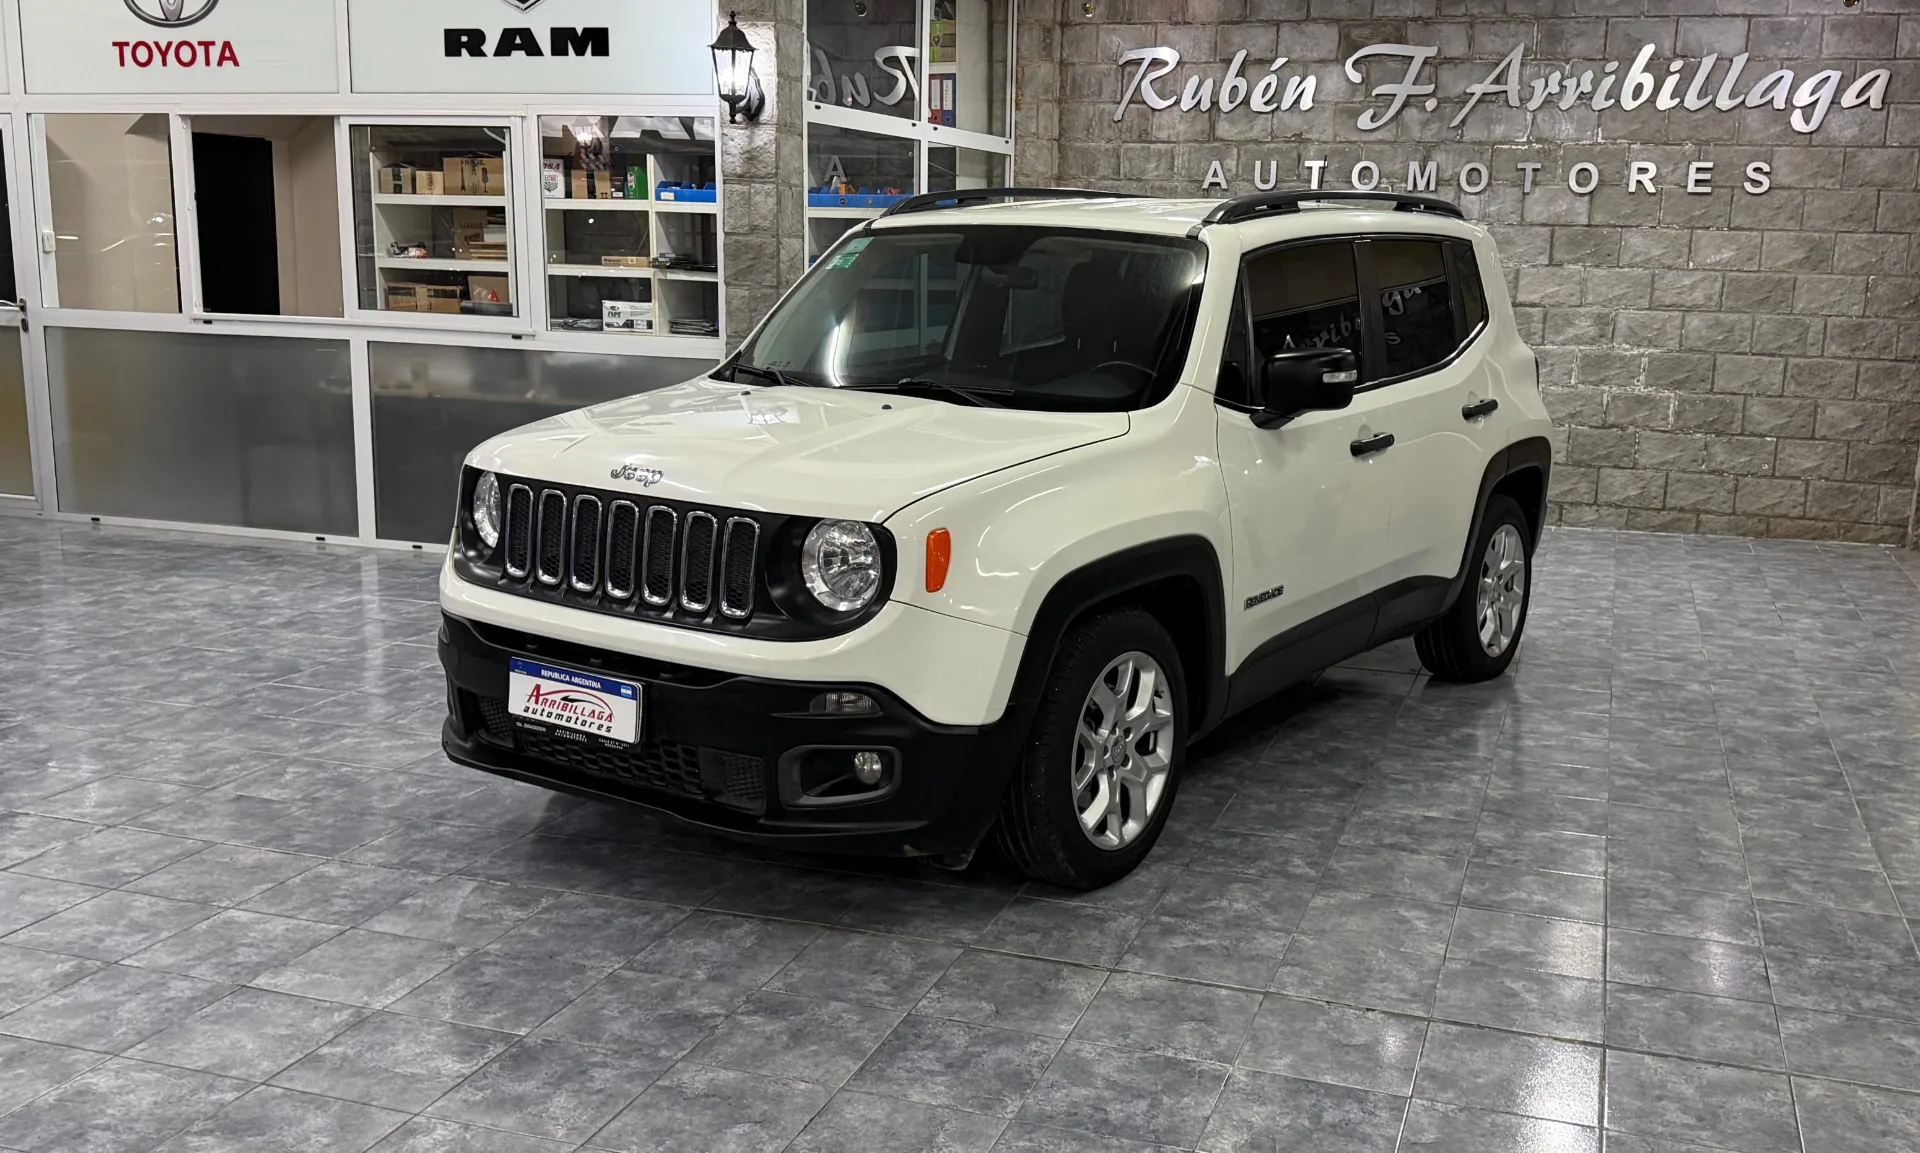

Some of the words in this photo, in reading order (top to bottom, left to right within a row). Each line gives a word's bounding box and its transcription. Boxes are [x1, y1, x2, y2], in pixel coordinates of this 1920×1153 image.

[112, 40, 240, 68] TOYOTA
[444, 27, 610, 57] RAM
[1114, 45, 1317, 122] Rubén
[1345, 43, 1440, 130] F.
[1450, 43, 1891, 133] Arribillaga
[1202, 160, 1773, 195] AUTOMOTORES
[610, 463, 664, 487] Jeep
[1244, 585, 1284, 611] RENEGADE
[541, 669, 570, 682] REPUBLICA
[571, 676, 602, 689] ARGENTINA
[525, 684, 615, 723] ARRIBILLAGA
[523, 705, 613, 733] automotores
